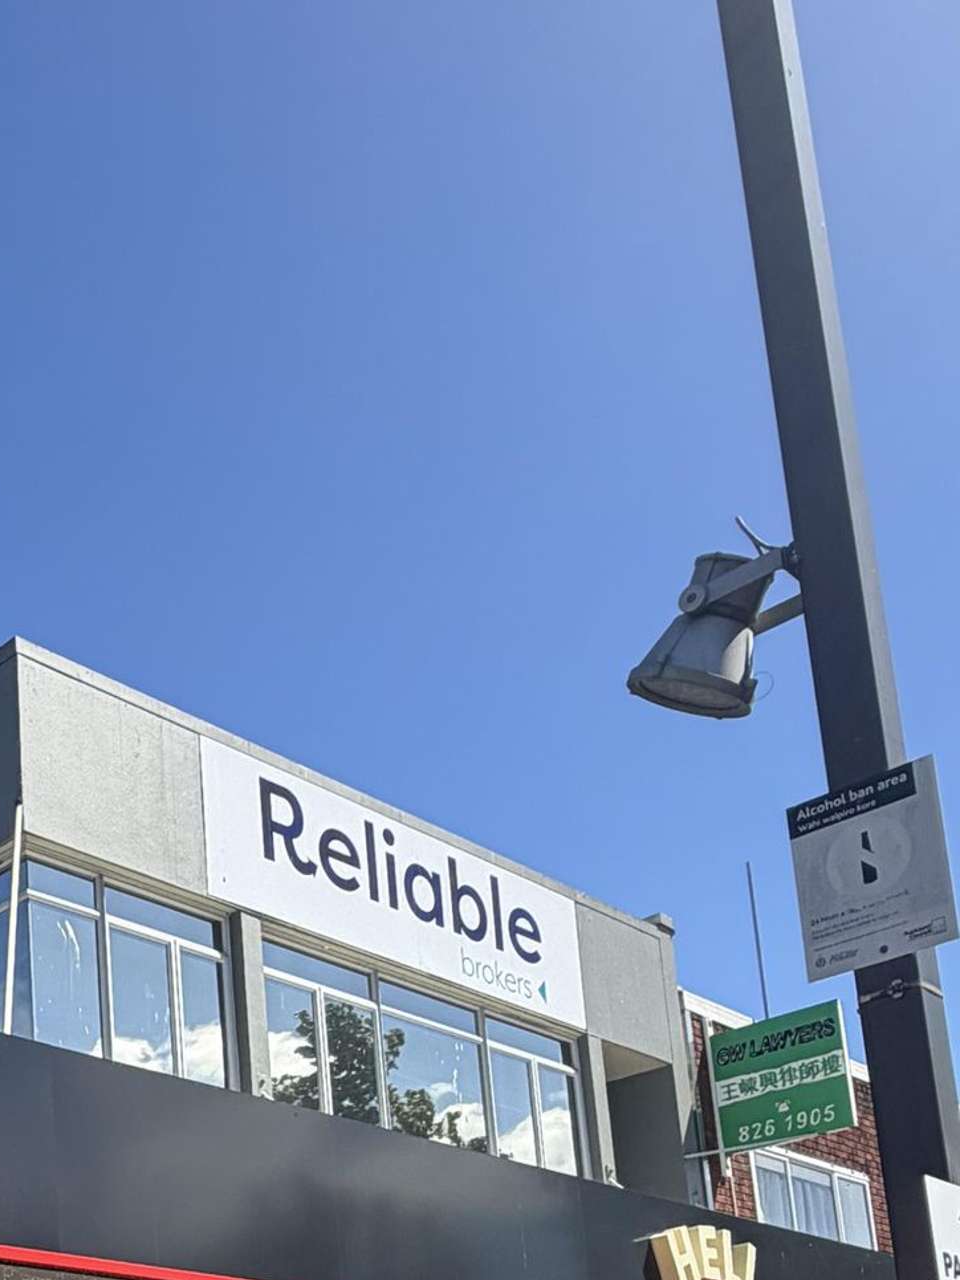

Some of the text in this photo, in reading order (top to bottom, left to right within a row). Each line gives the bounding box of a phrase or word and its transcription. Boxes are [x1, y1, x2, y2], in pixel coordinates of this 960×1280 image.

[796, 772, 908, 821] Alcohol ban area
[258, 776, 543, 965] Reliable
[460, 948, 533, 999] brokers
[716, 1017, 837, 1067] GW LAWYERS
[738, 1104, 836, 1143] 826 1905
